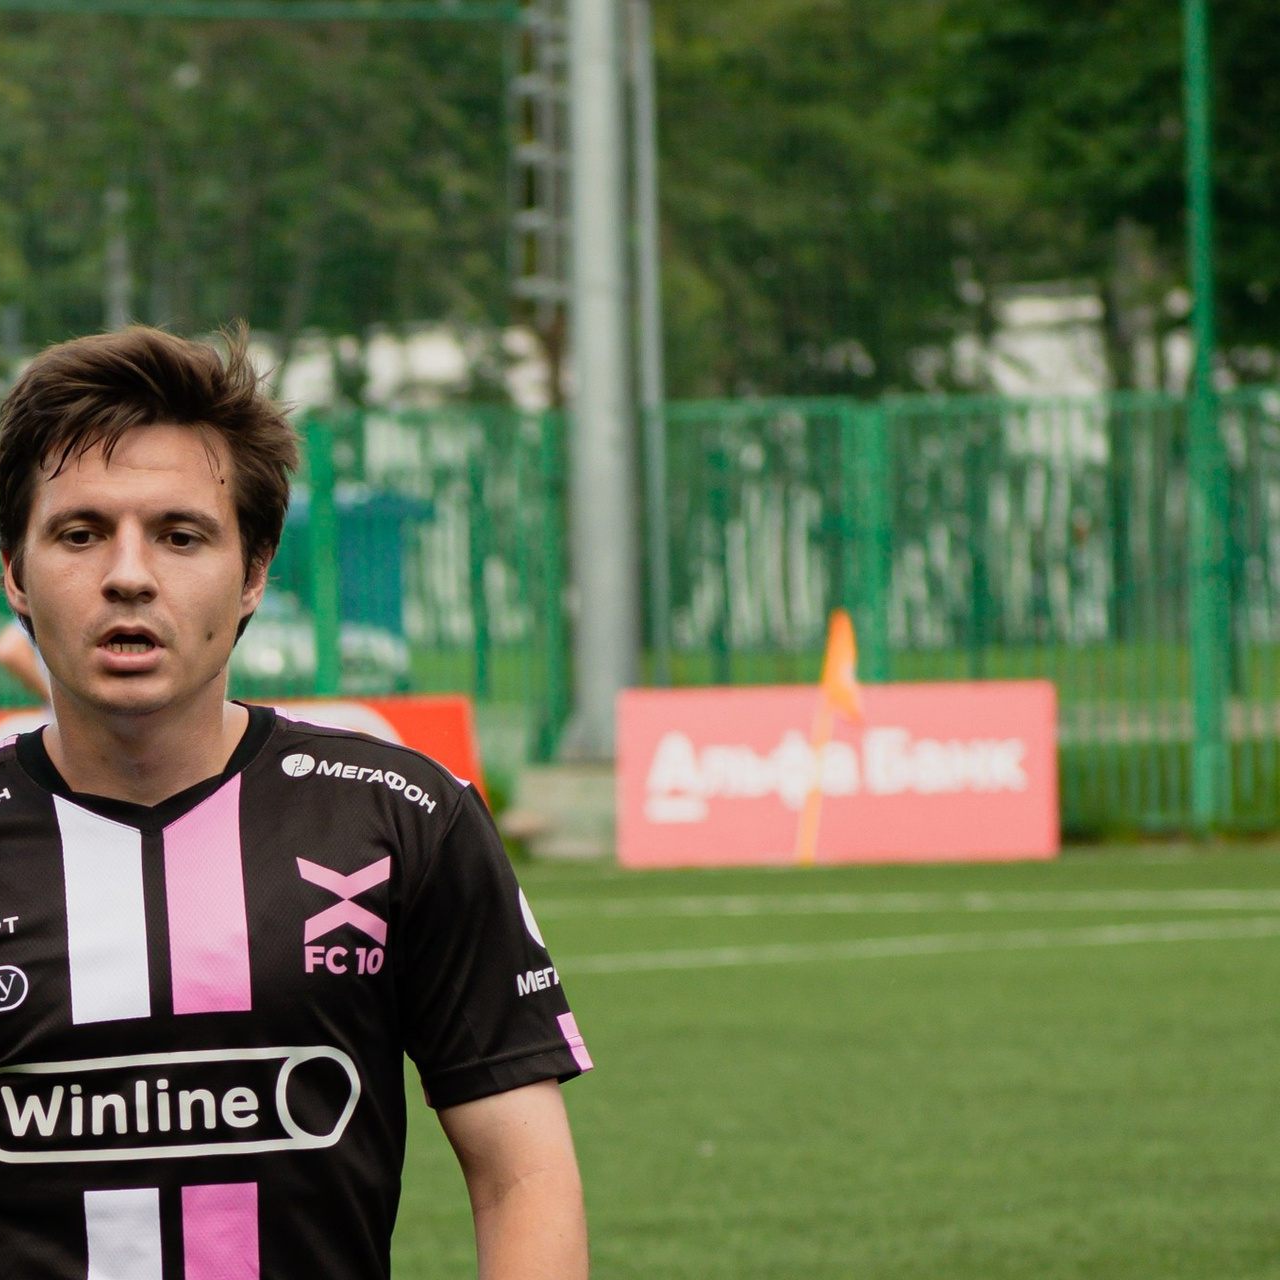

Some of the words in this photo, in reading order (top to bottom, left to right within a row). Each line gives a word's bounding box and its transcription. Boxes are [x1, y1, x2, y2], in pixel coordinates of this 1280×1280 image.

[304, 946, 348, 974] FC
[356, 947, 384, 975] 10
[0, 1079, 259, 1137] Winline
